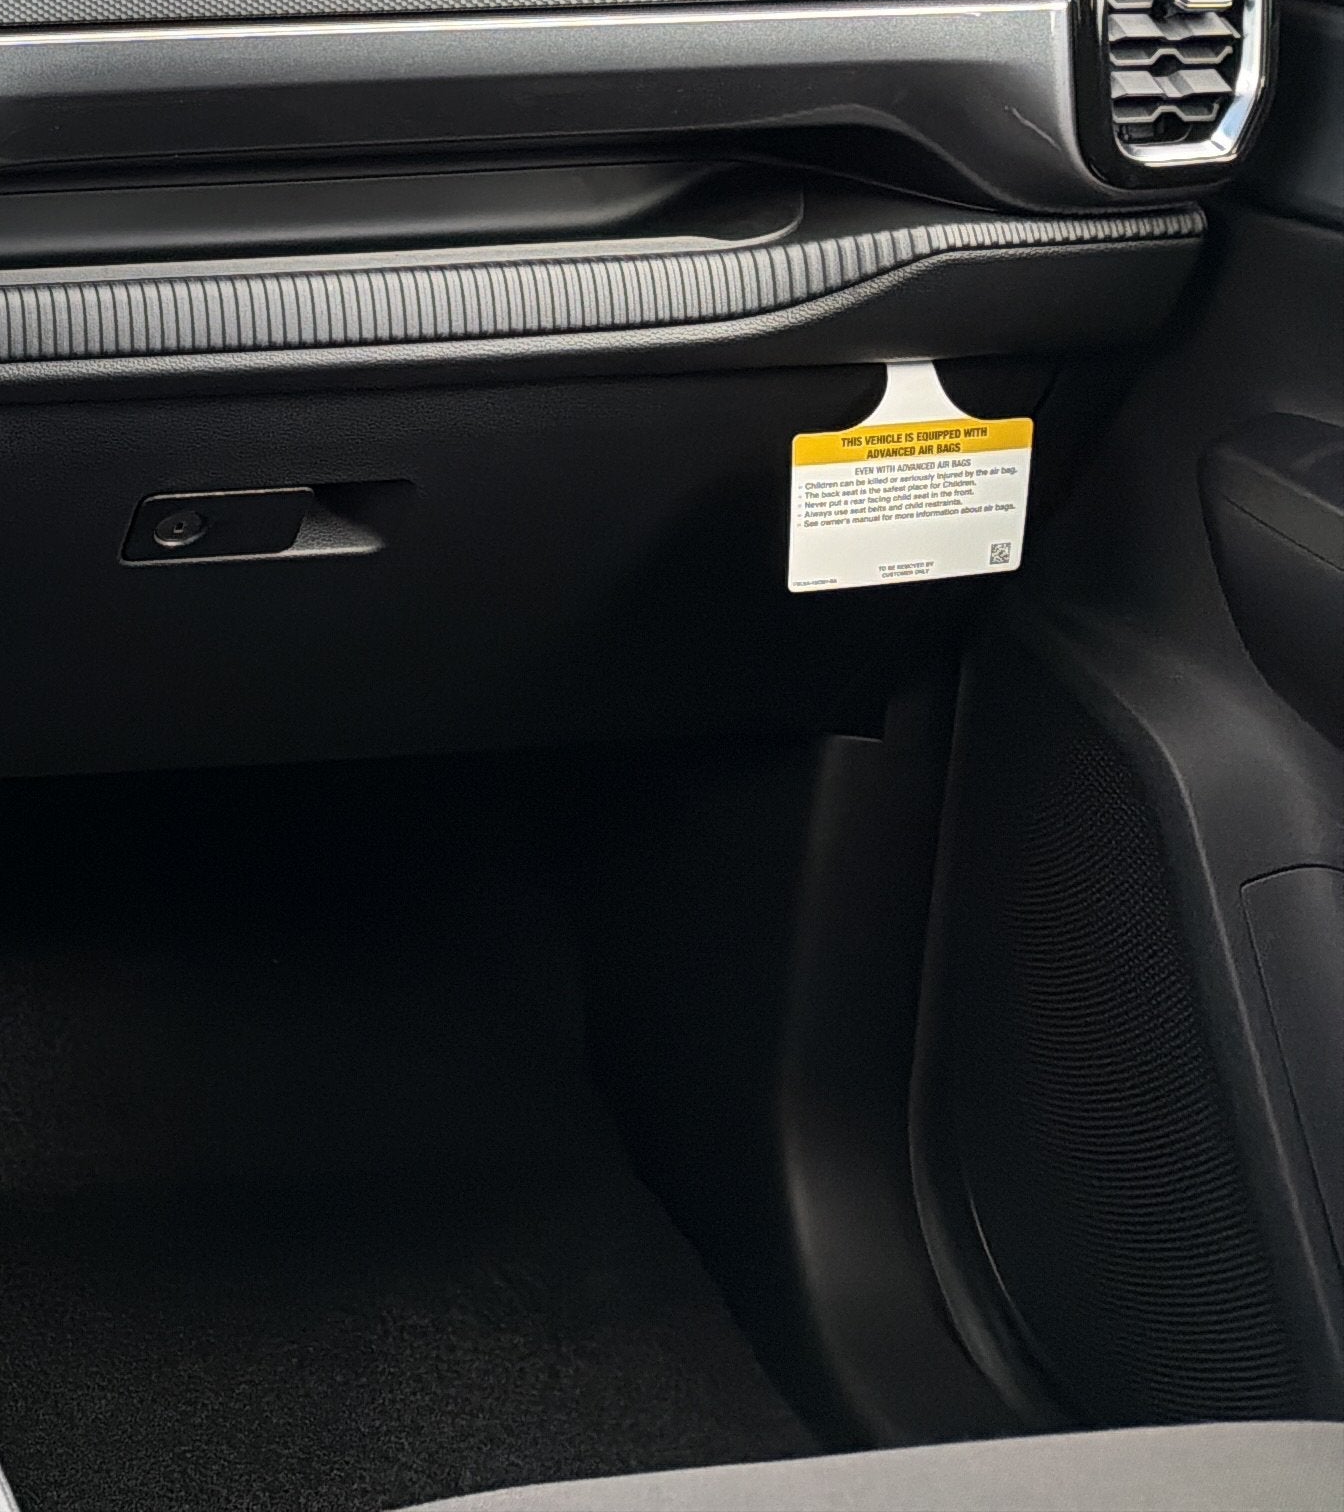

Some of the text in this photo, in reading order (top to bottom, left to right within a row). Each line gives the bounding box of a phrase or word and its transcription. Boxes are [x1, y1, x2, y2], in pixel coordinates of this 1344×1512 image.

[841, 427, 988, 448] THIS VEHICLE IS EQUIPPED WITH
[867, 442, 961, 459] ADVANCED AIR BAGS
[855, 459, 972, 476] EVEN WITH ADVANCED AIR BAGS
[804, 480, 838, 490] Children
[840, 480, 854, 488] can
[867, 476, 888, 485] killed
[900, 473, 935, 483] seriously
[965, 469, 974, 478] by
[975, 468, 988, 476] the
[989, 467, 999, 475] air
[804, 500, 827, 509] Never
[829, 499, 842, 508] put
[850, 497, 865, 505] rear
[867, 495, 891, 504] facing
[893, 494, 911, 502] child
[913, 492, 929, 500] seat
[940, 490, 952, 498] the
[805, 491, 820, 499] The
[821, 490, 840, 498] back
[841, 488, 858, 497] seat
[882, 484, 906, 493] safest
[908, 483, 928, 492] place
[804, 510, 832, 519] Always
[834, 508, 848, 516] use
[850, 507, 866, 515] seat
[868, 505, 886, 513] belts
[888, 503, 902, 511] and
[904, 501, 924, 509] child
[804, 519, 818, 528] See
[852, 515, 880, 524] manual
[882, 513, 893, 521] for
[894, 512, 914, 520] more
[916, 507, 959, 518] information
[960, 505, 983, 514] about
[984, 504, 994, 512] air
